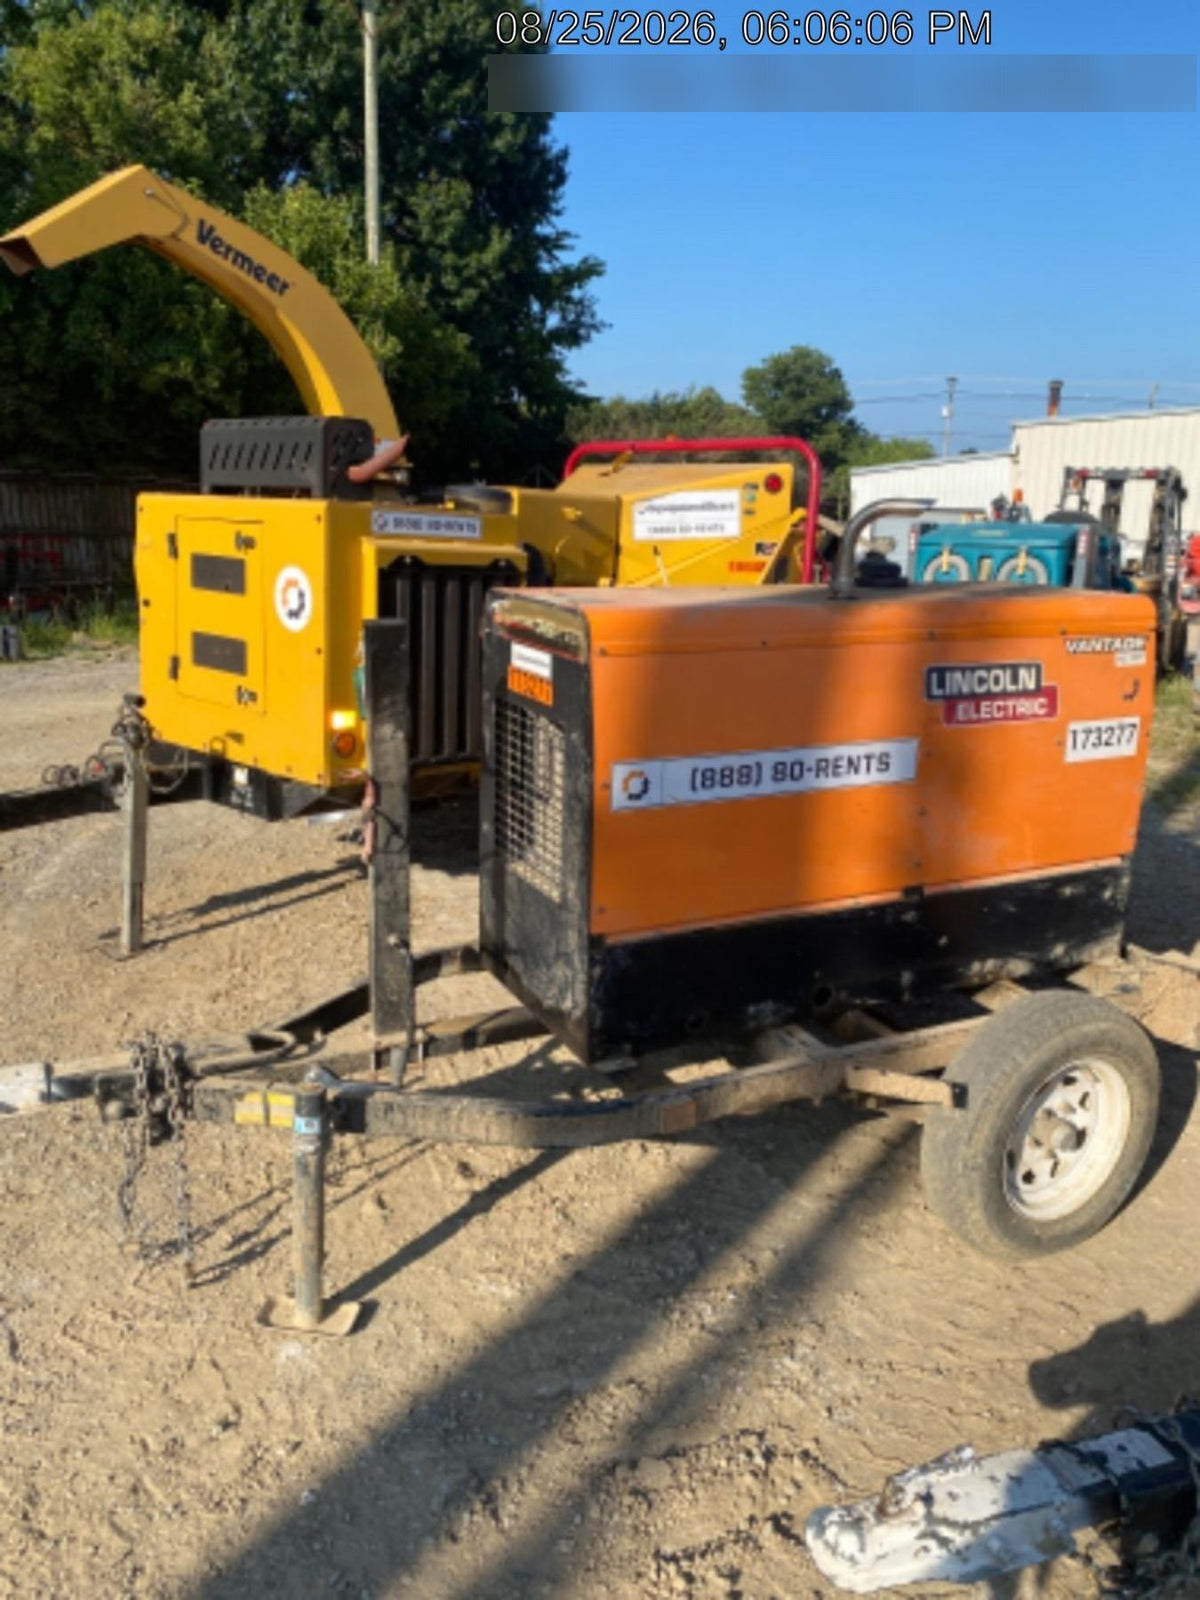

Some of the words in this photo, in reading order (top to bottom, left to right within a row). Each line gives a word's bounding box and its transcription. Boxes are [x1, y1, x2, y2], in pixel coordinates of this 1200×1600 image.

[196, 218, 290, 296] Vermeer
[1064, 636, 1148, 655] VANTAGE
[929, 665, 1037, 696] LINCOLN
[956, 697, 1050, 722] ELECTRIC
[1069, 722, 1138, 751] 173277
[690, 762, 763, 792] (888)
